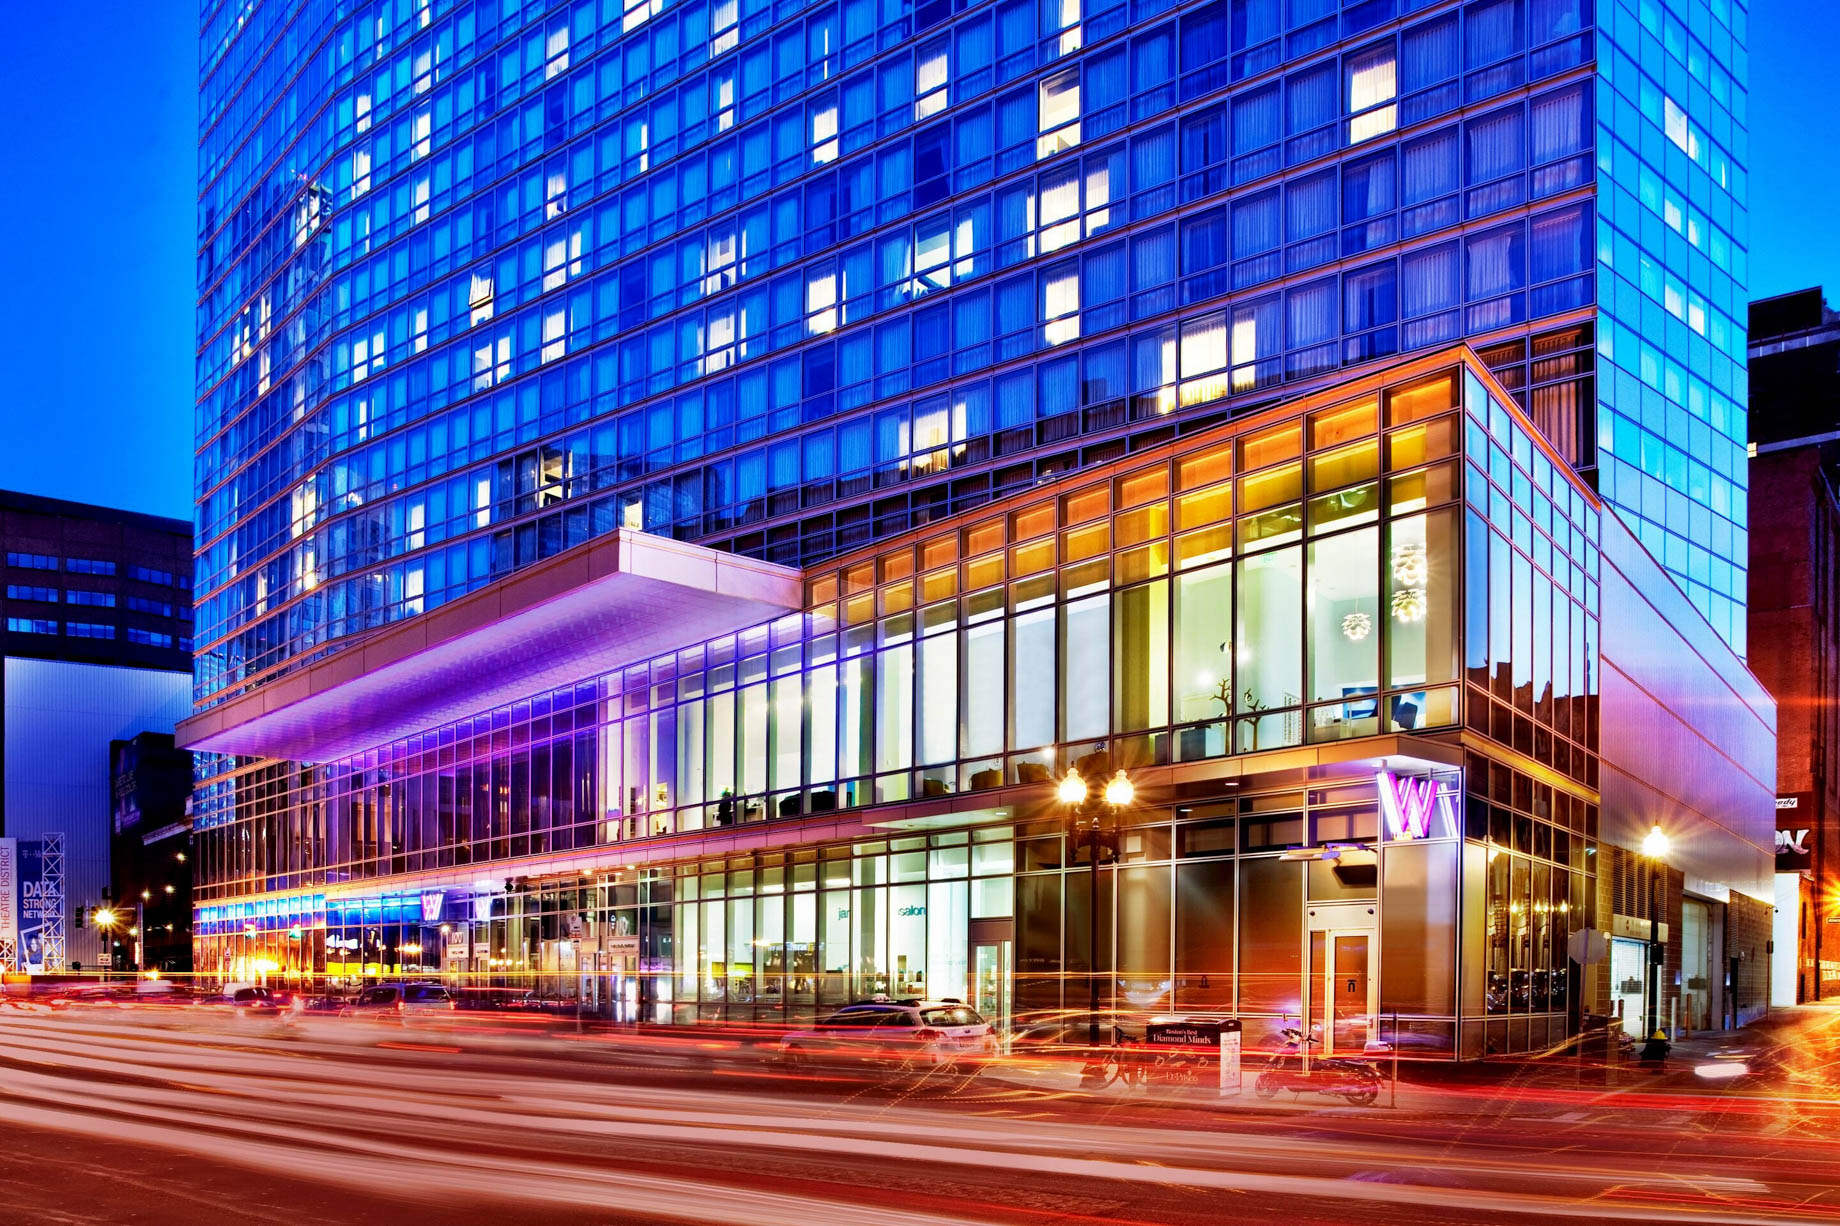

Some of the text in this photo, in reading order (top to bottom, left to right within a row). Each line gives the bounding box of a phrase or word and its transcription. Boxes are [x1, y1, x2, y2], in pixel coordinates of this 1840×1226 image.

[1376, 771, 1439, 838] W
[1776, 798, 1796, 806] edy
[1, 846, 10, 929] THEATRE DISTRICT
[23, 881, 57, 898] DATA
[23, 898, 57, 909] STRONG
[898, 905, 926, 916] salon
[1153, 1033, 1212, 1044] Diamond Minds
